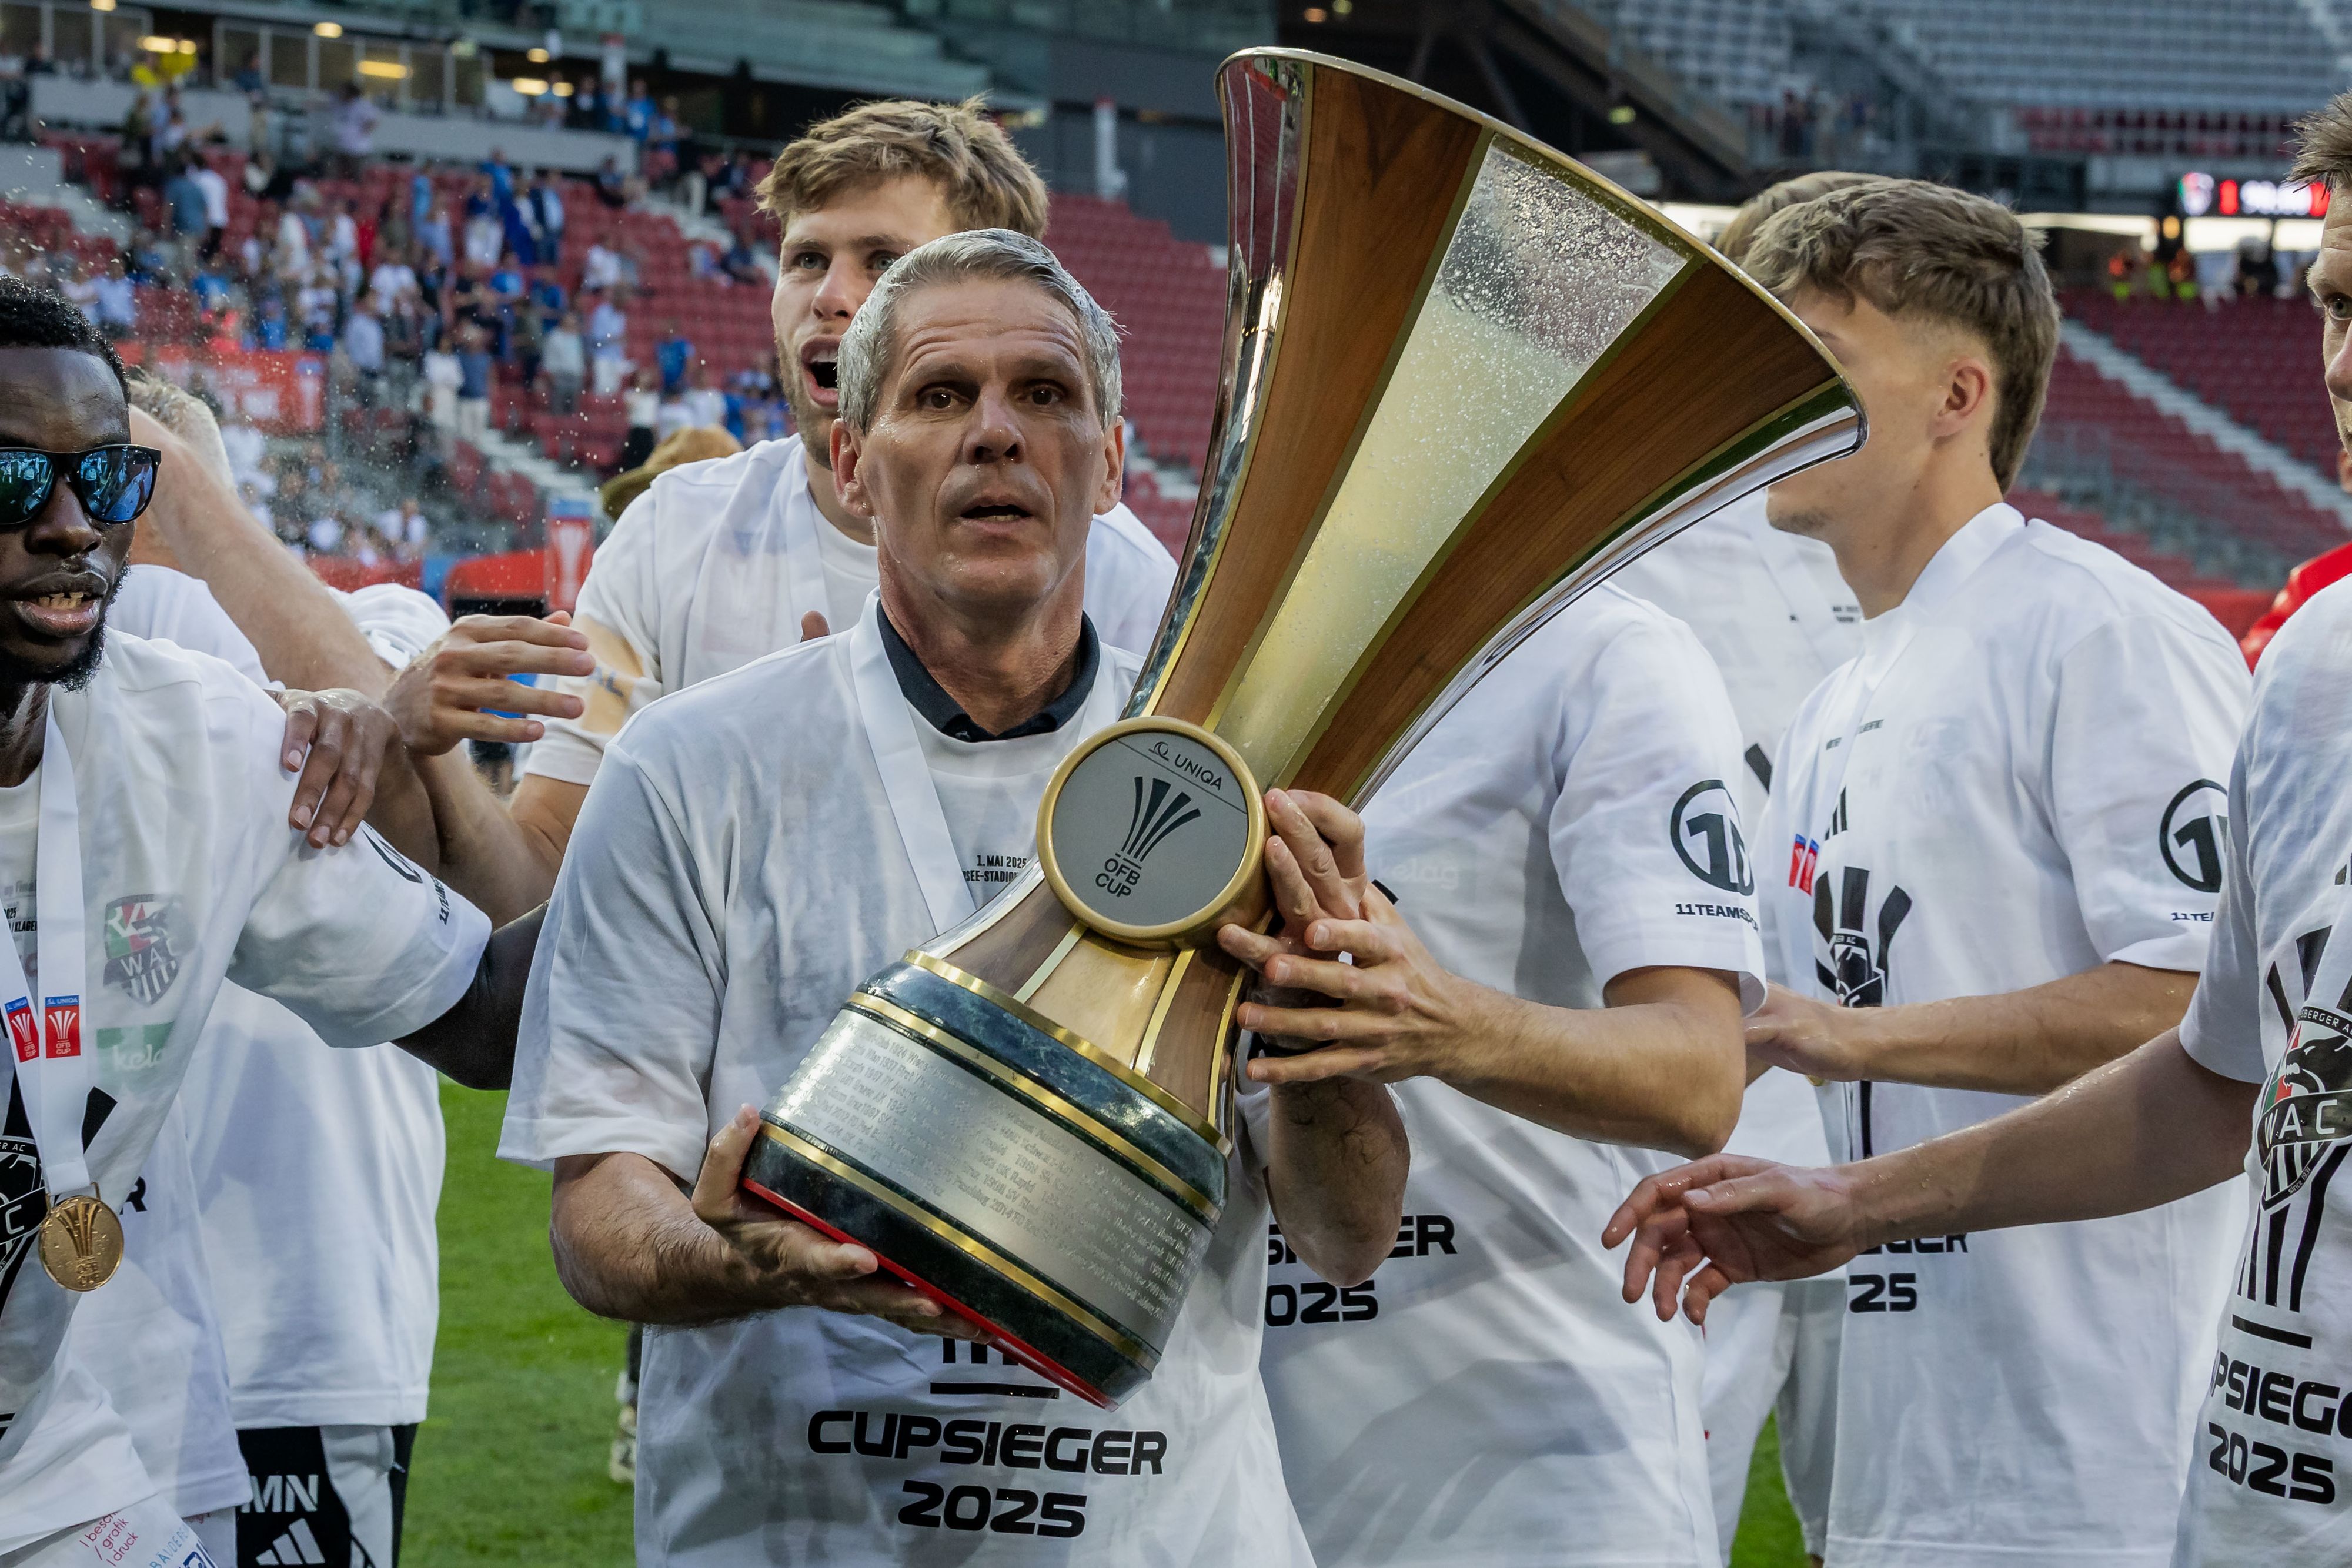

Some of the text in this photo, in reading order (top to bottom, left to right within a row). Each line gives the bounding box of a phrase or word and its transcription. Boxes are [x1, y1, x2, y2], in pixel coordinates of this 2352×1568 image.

[1174, 754, 1222, 791] UNIQA
[987, 855, 1003, 867] MAI
[1006, 856, 1028, 869] 2025
[1095, 873, 1132, 898] CUP
[2264, 1099, 2338, 1149] WAC
[12, 1143, 25, 1152] AC
[2288, 1180, 2303, 1194] since
[808, 1410, 1167, 1475] CUPSIEGER
[2209, 1421, 2335, 1505] 2025
[898, 1480, 1087, 1538] 2025
[103, 1518, 129, 1549] grafik
[113, 1532, 138, 1562] druck
